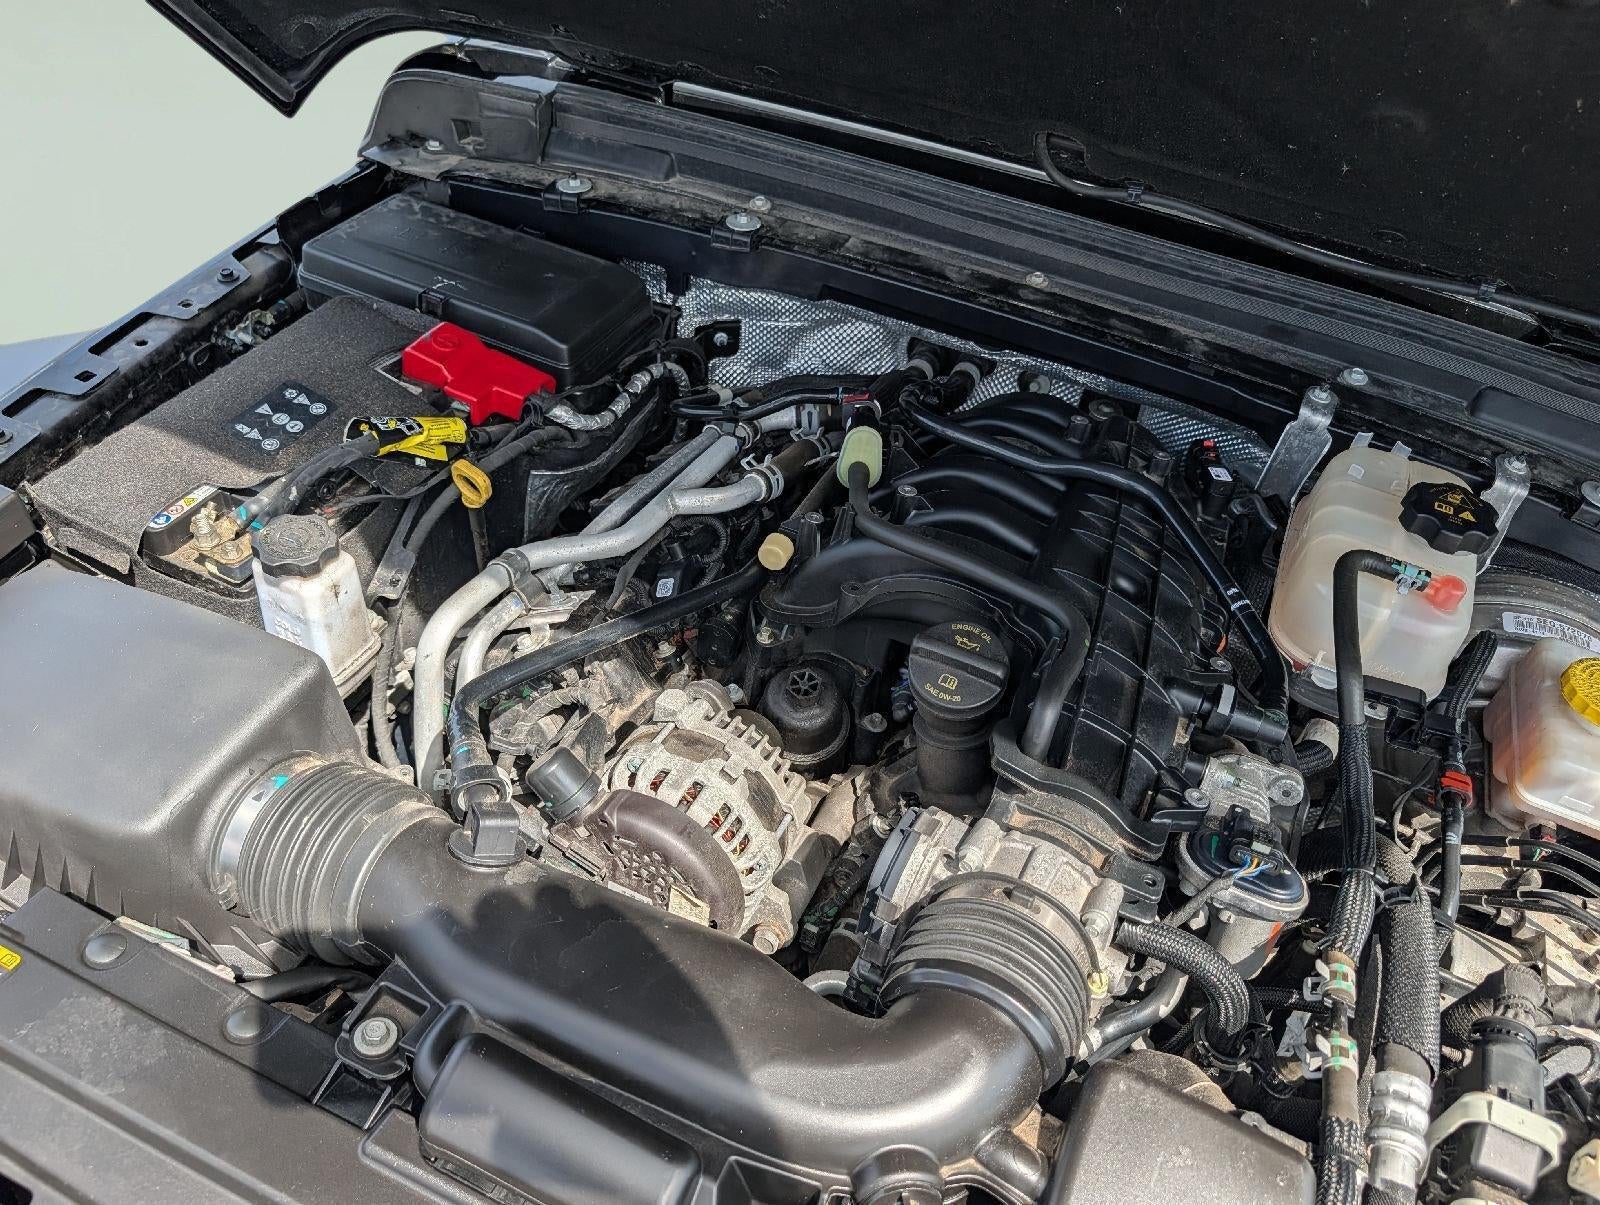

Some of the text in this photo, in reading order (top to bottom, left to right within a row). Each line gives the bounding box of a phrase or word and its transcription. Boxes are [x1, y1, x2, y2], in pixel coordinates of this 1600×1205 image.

[951, 623, 992, 643] ENGINE OIL
[925, 683, 961, 702] SAE 0W-20
